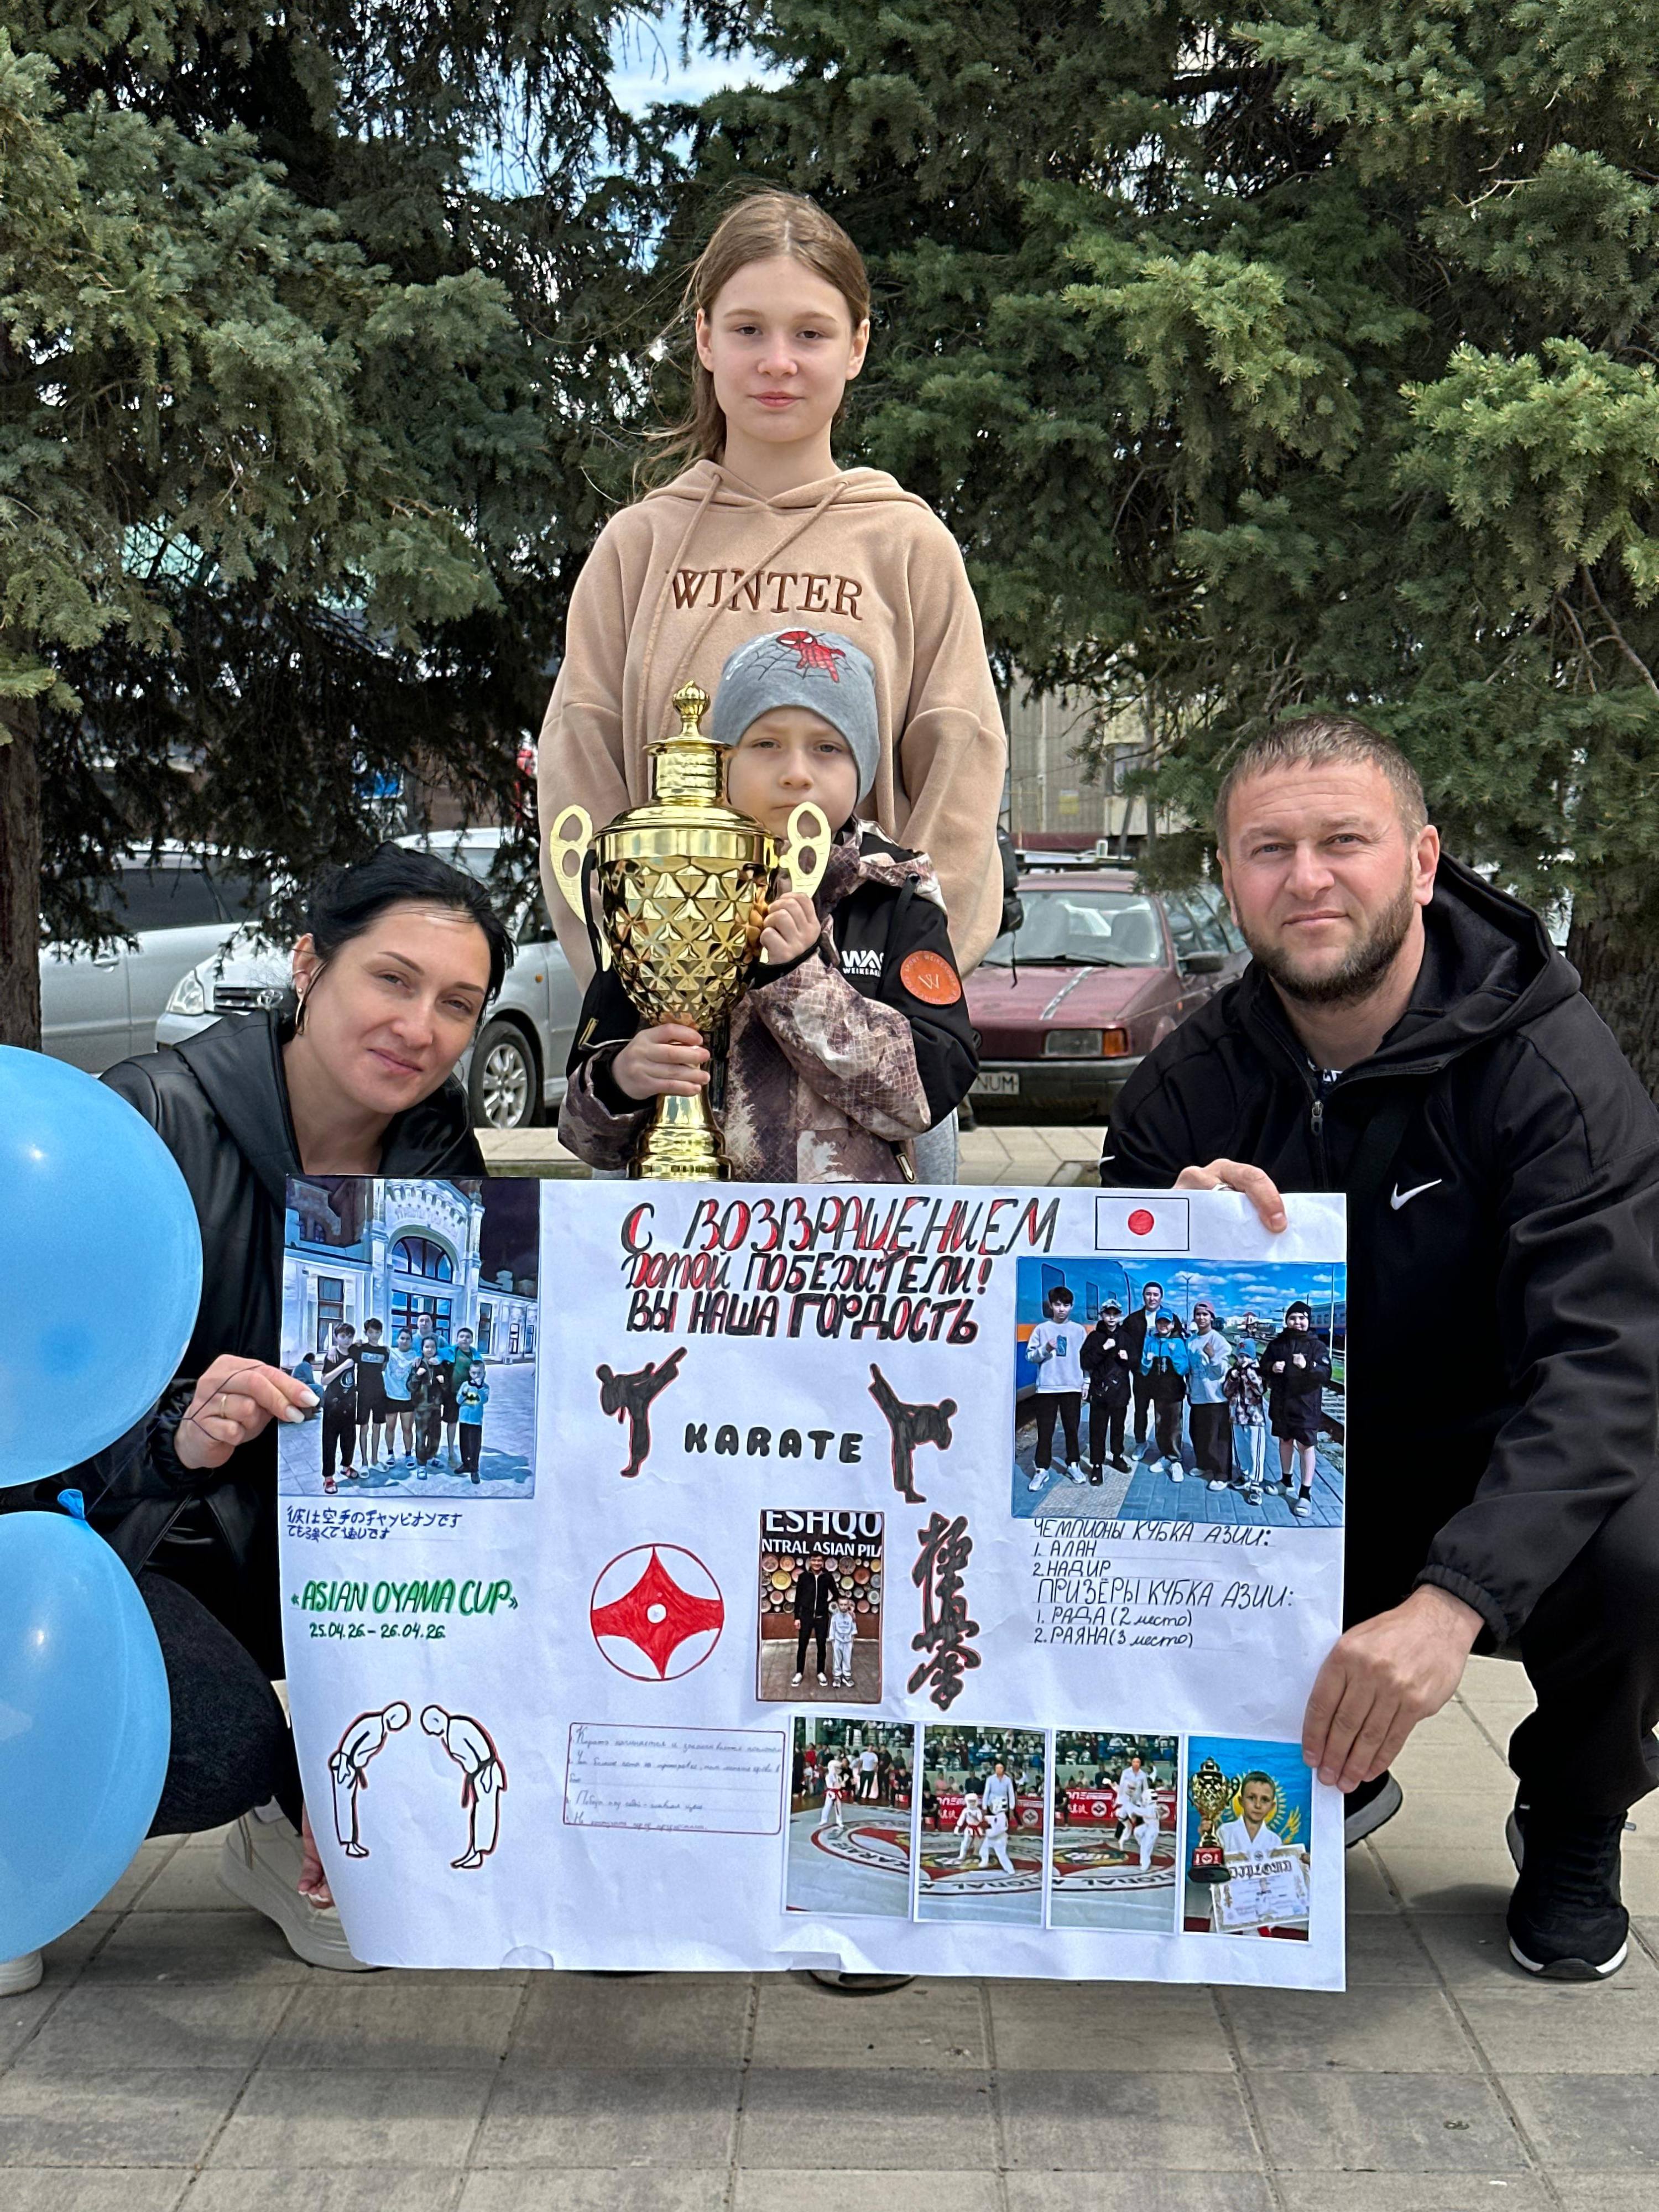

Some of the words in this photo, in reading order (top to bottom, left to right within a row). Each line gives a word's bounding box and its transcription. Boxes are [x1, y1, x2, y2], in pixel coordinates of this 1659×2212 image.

[666, 567, 863, 620] WINTER
[620, 1202, 655, 1254] С
[682, 1196, 1061, 1255] ВОЗВРАЩЕНИЕМ
[743, 1250, 993, 1295] ПОБЕДИТЕЛИ!
[626, 1288, 679, 1332] ВЫ
[687, 1290, 780, 1338] НАША
[786, 1292, 979, 1345] ГОРДОСТЬ
[684, 1422, 863, 1464] KARATE
[1034, 1518, 1125, 1540] ЧЕМПИОНЫ
[1132, 1520, 1194, 1542] КУБКА
[1204, 1525, 1271, 1546] АЗИИ:
[813, 1541, 854, 1557] ASIAN
[1034, 1542, 1041, 1557] 1.
[1050, 1540, 1097, 1557] АЛАН
[1047, 1559, 1111, 1577] НАДИР
[372, 1578, 456, 1614] OYAMA
[1037, 1578, 1140, 1604] ПРИЗЁРЫ
[1148, 1579, 1214, 1607] КУБКА
[1220, 1581, 1294, 1610] АЗИИ:
[1036, 1609, 1045, 1624] 1.
[1052, 1606, 1105, 1625] РАДА
[1034, 1627, 1047, 1644] 2.
